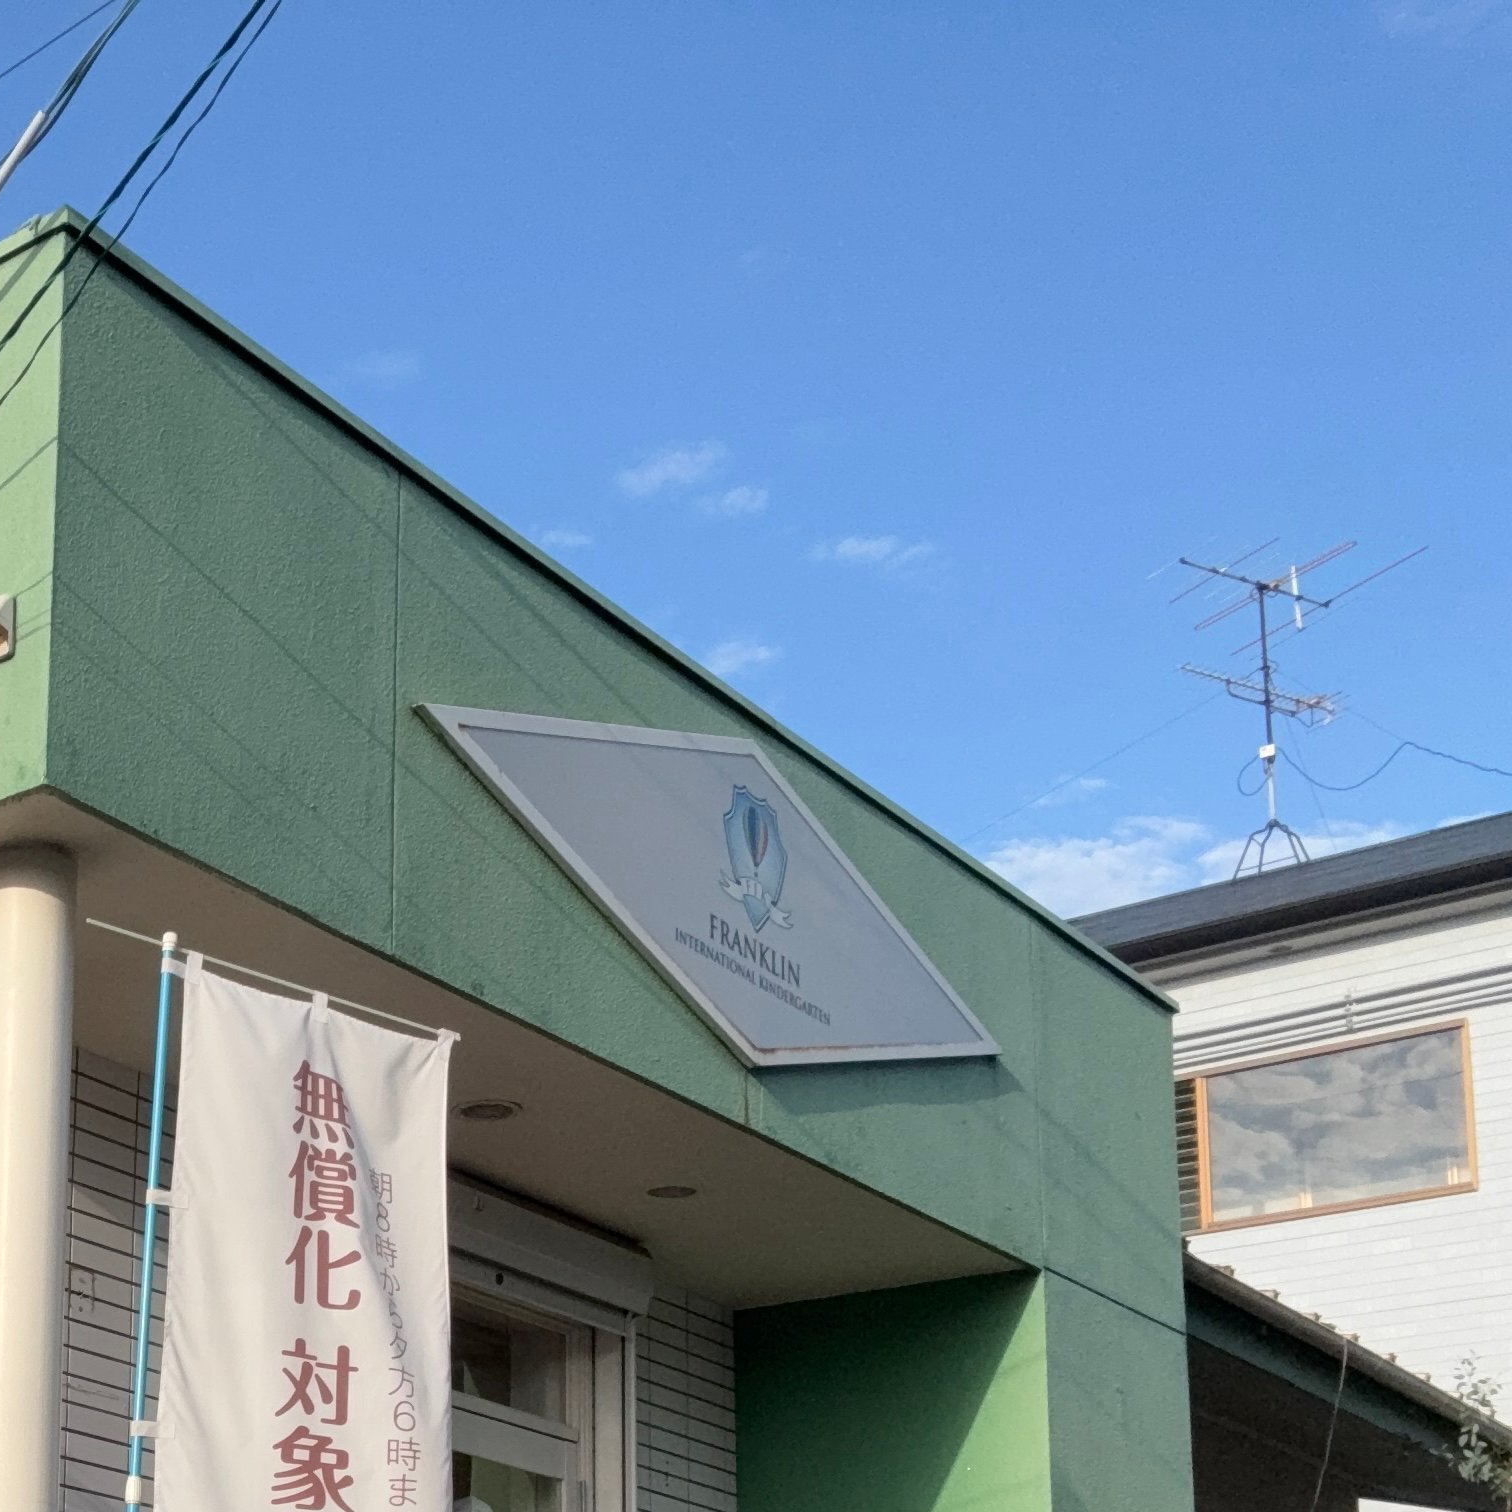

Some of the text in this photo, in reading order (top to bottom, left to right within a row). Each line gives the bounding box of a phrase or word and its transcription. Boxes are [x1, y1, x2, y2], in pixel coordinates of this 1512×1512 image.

[675, 926, 832, 1027] INTERNATIONAL KINDERGARTEN
[709, 912, 801, 989] FRANKLIN
